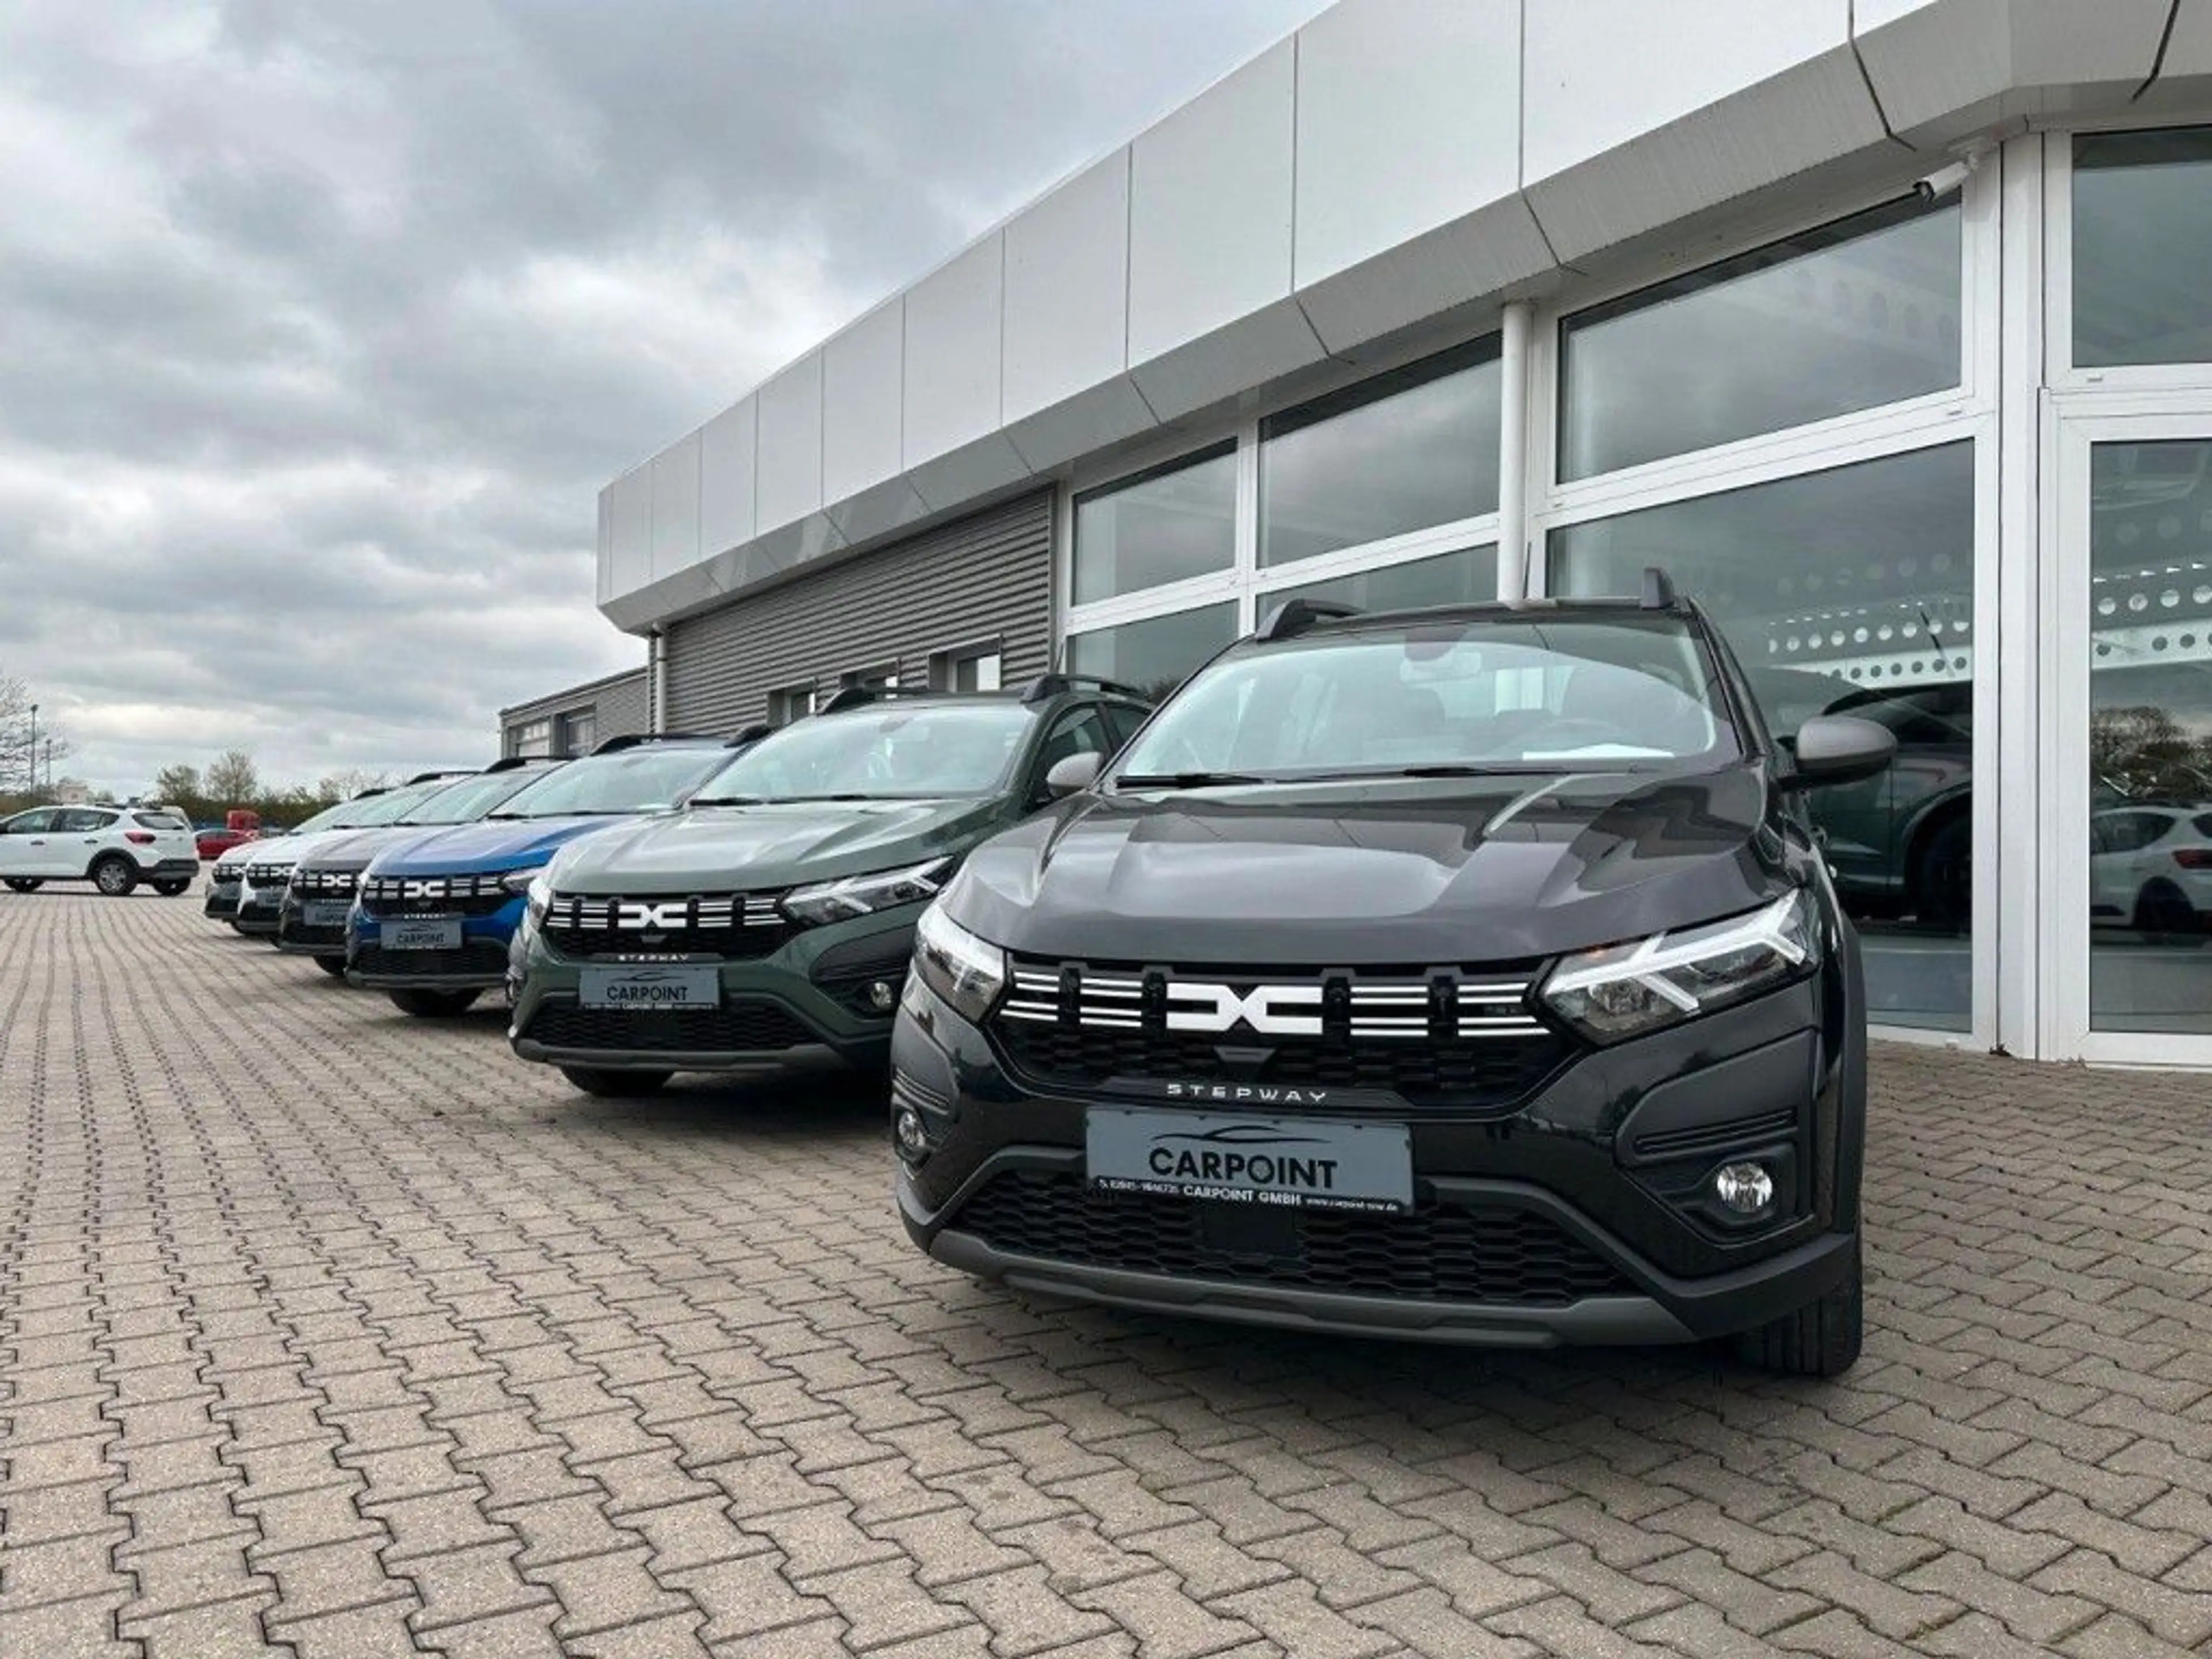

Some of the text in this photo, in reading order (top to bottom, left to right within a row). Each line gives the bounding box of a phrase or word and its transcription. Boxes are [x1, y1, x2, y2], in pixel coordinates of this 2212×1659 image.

[607, 985, 688, 1001] CARPOINT
[1167, 1084, 1326, 1102] STEPWAY
[1149, 1147, 1338, 1188] CARPOINT
[1183, 1185, 1253, 1203] CARPOINT
